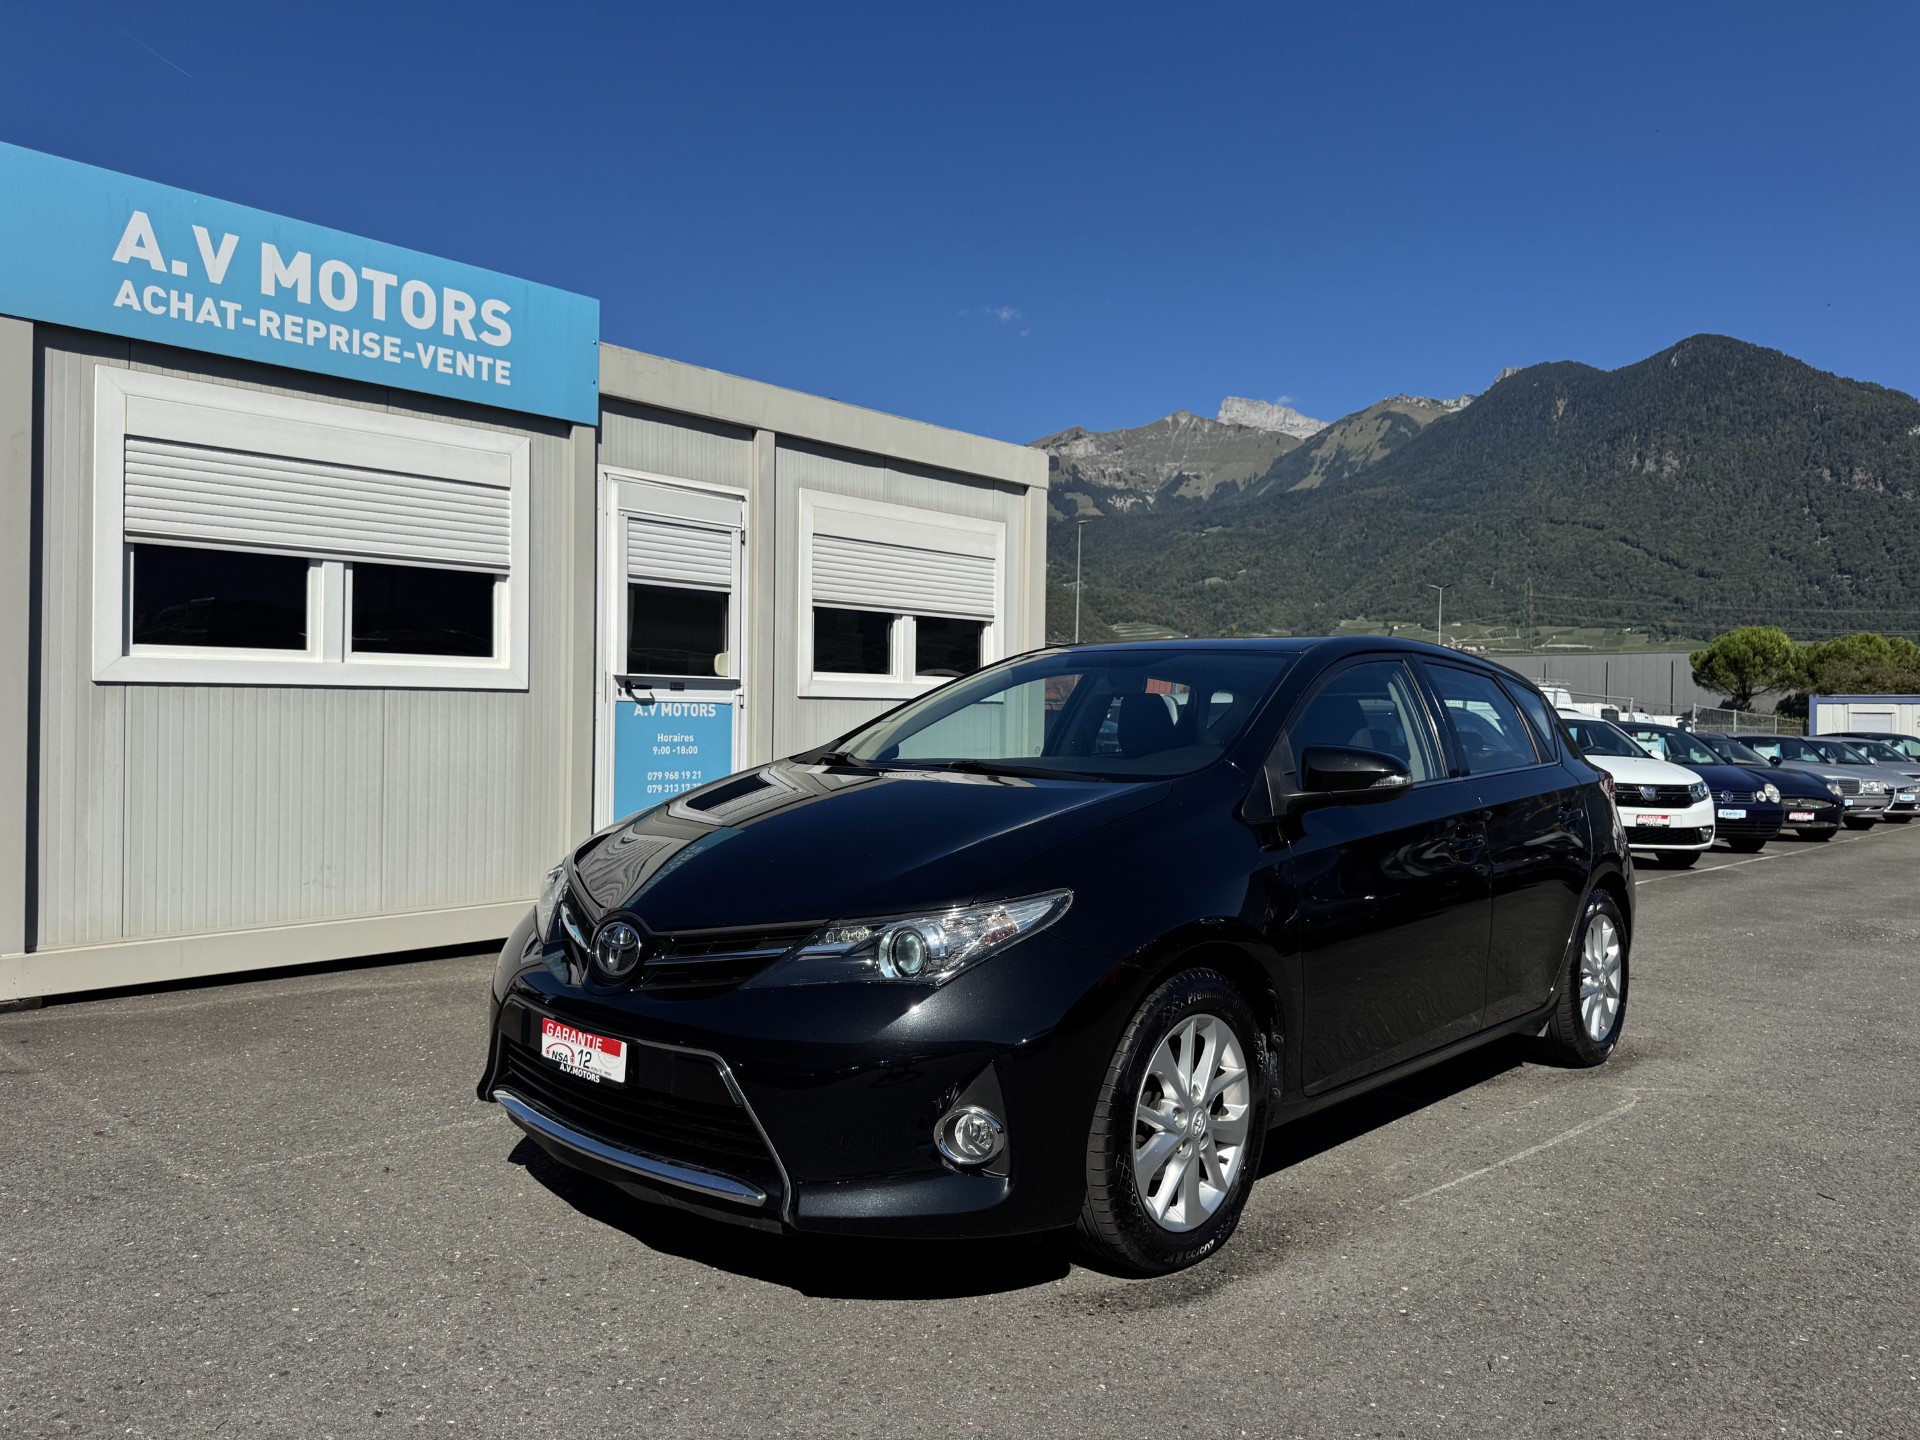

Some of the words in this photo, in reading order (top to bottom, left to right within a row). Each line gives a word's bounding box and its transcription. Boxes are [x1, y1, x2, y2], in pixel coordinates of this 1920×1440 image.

[112, 210, 240, 285] A.V
[261, 242, 512, 347] MOTORS
[113, 279, 512, 387] ACHAT-REPRISE-VENTE
[633, 702, 658, 717] A.V
[661, 703, 717, 717] MOTORS
[657, 733, 695, 743] Horaires
[652, 746, 671, 755] 9:00
[647, 771, 663, 781] 079
[664, 771, 679, 780] 968
[681, 770, 691, 780] 19
[692, 770, 702, 780] 21
[646, 784, 663, 794] 079
[664, 783, 679, 793] 313
[546, 1023, 603, 1052] GARANTIE
[551, 1050, 569, 1064] NSA
[577, 1049, 592, 1069] 12
[560, 1063, 600, 1083] A.V.MOTORS
